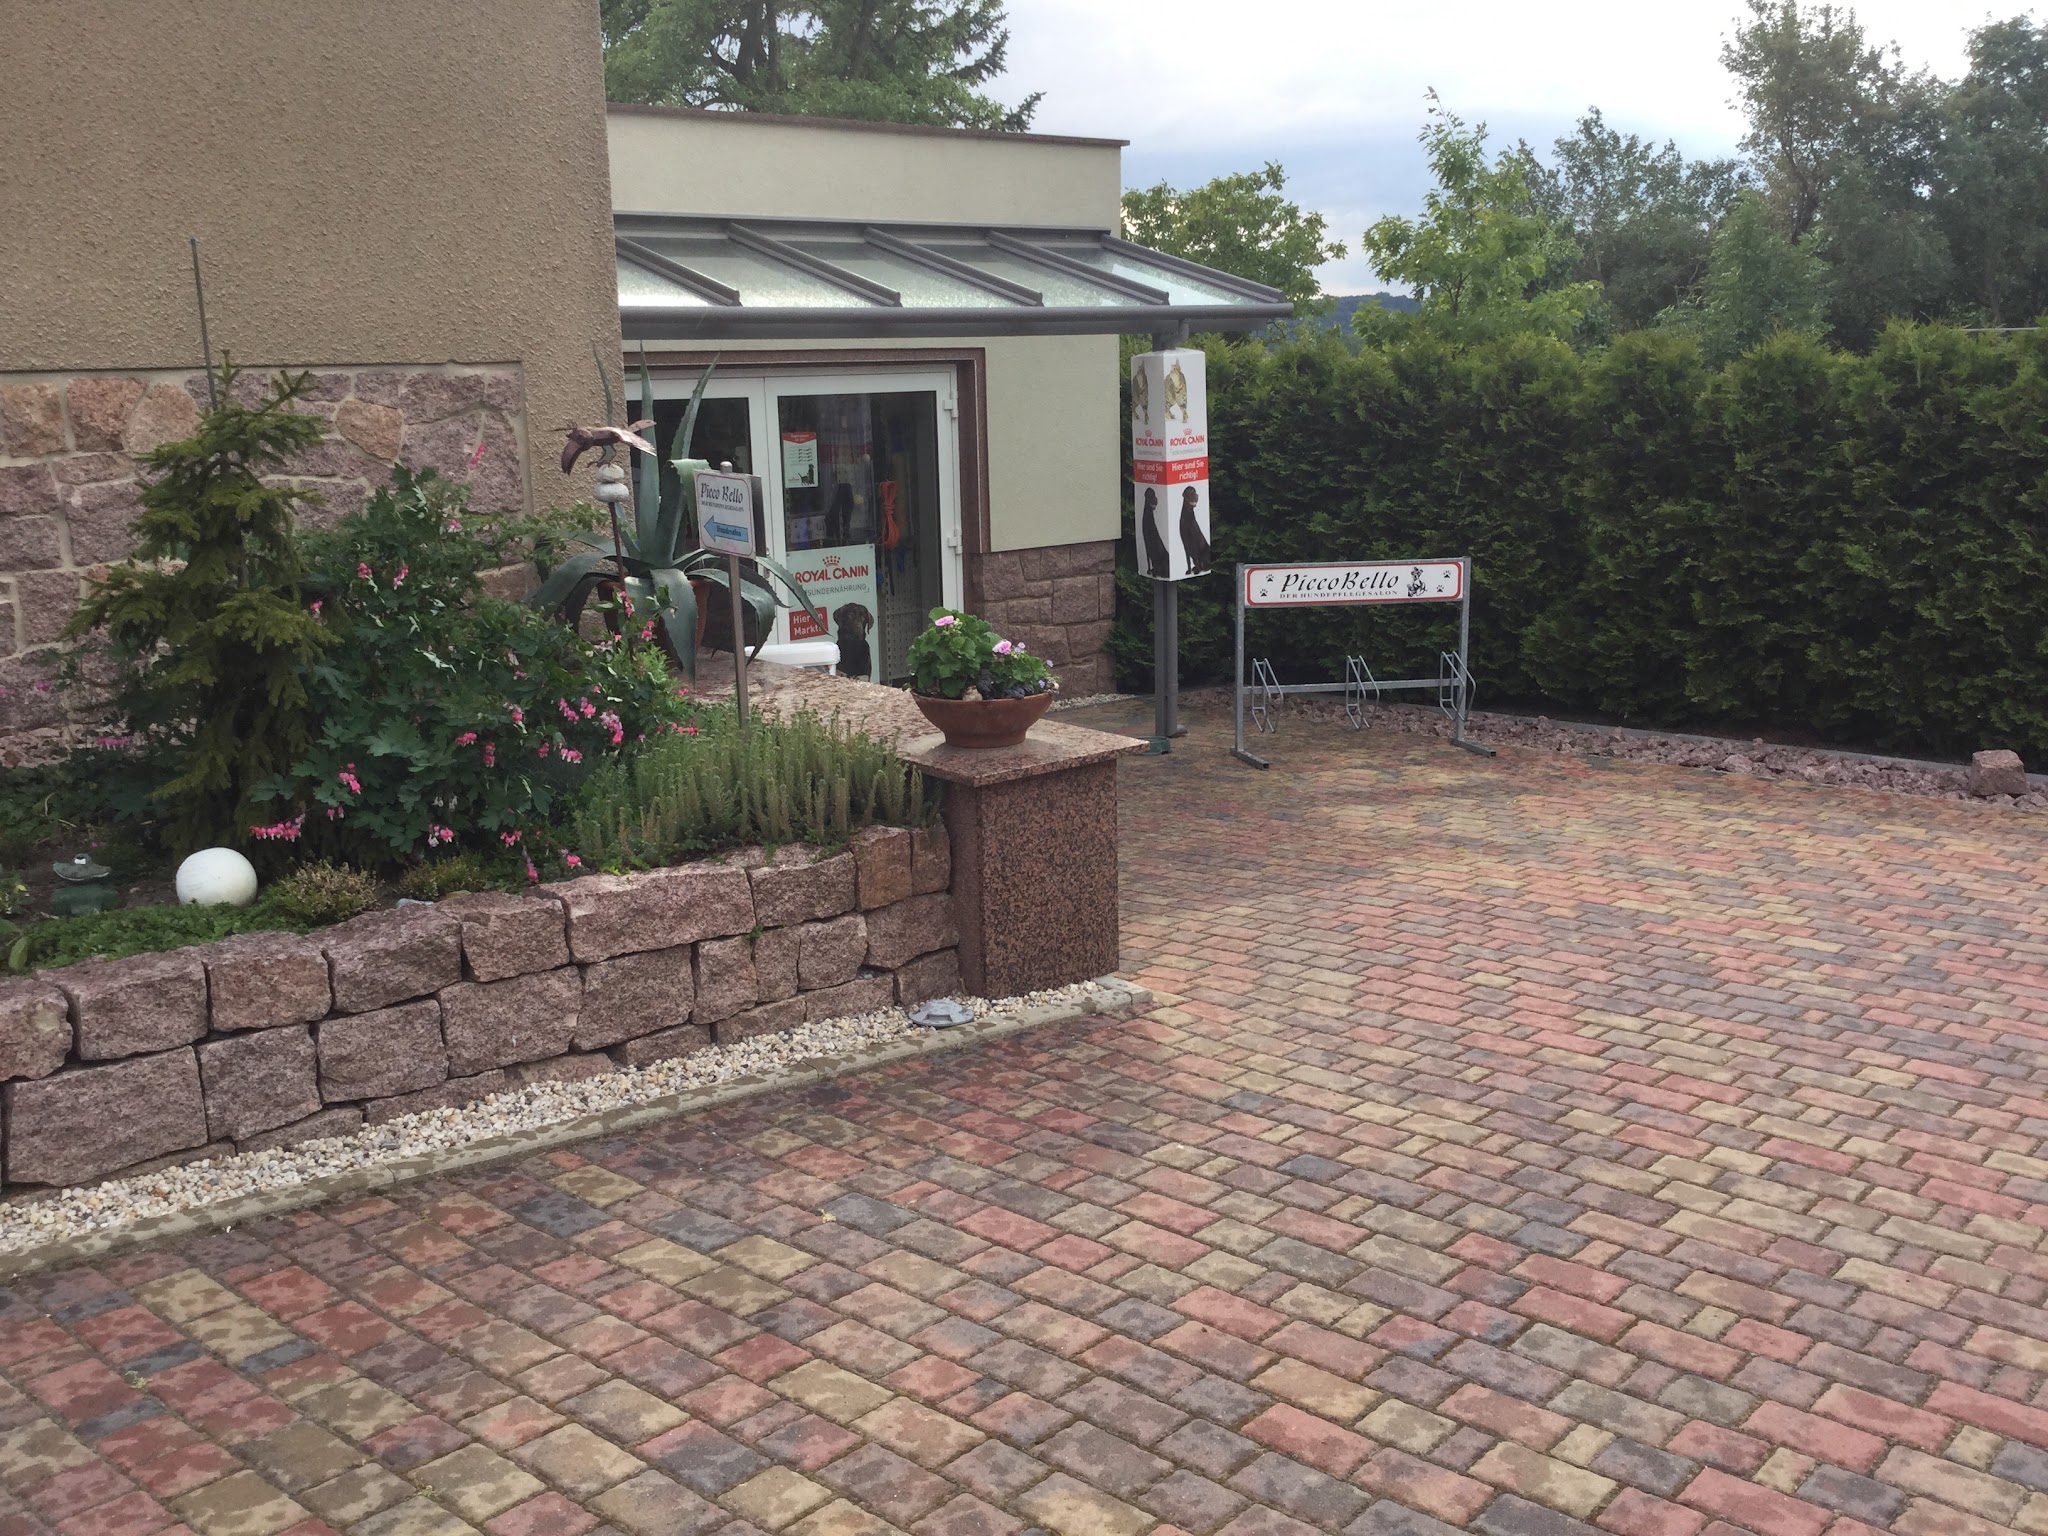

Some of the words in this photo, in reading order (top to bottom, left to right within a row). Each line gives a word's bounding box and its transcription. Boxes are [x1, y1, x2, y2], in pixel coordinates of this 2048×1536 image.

[1135, 438, 1148, 447] ROYAL
[1148, 438, 1164, 447] CANIN
[1170, 437, 1187, 447] ROYAL
[1188, 435, 1205, 445] CANIN
[1171, 461, 1184, 472] Hier
[1185, 460, 1196, 470] sind
[1196, 459, 1205, 469] Sie
[1179, 470, 1199, 481] richtig!
[701, 482, 720, 500] Picco
[722, 485, 744, 504] Bello
[795, 568, 831, 583] ROYAL
[832, 565, 869, 580] CANIN
[804, 583, 867, 597] SUNDERNÄHRUNG
[1300, 590, 1398, 599] HUNDEPFLEGESALON
[793, 615, 811, 625] Hier
